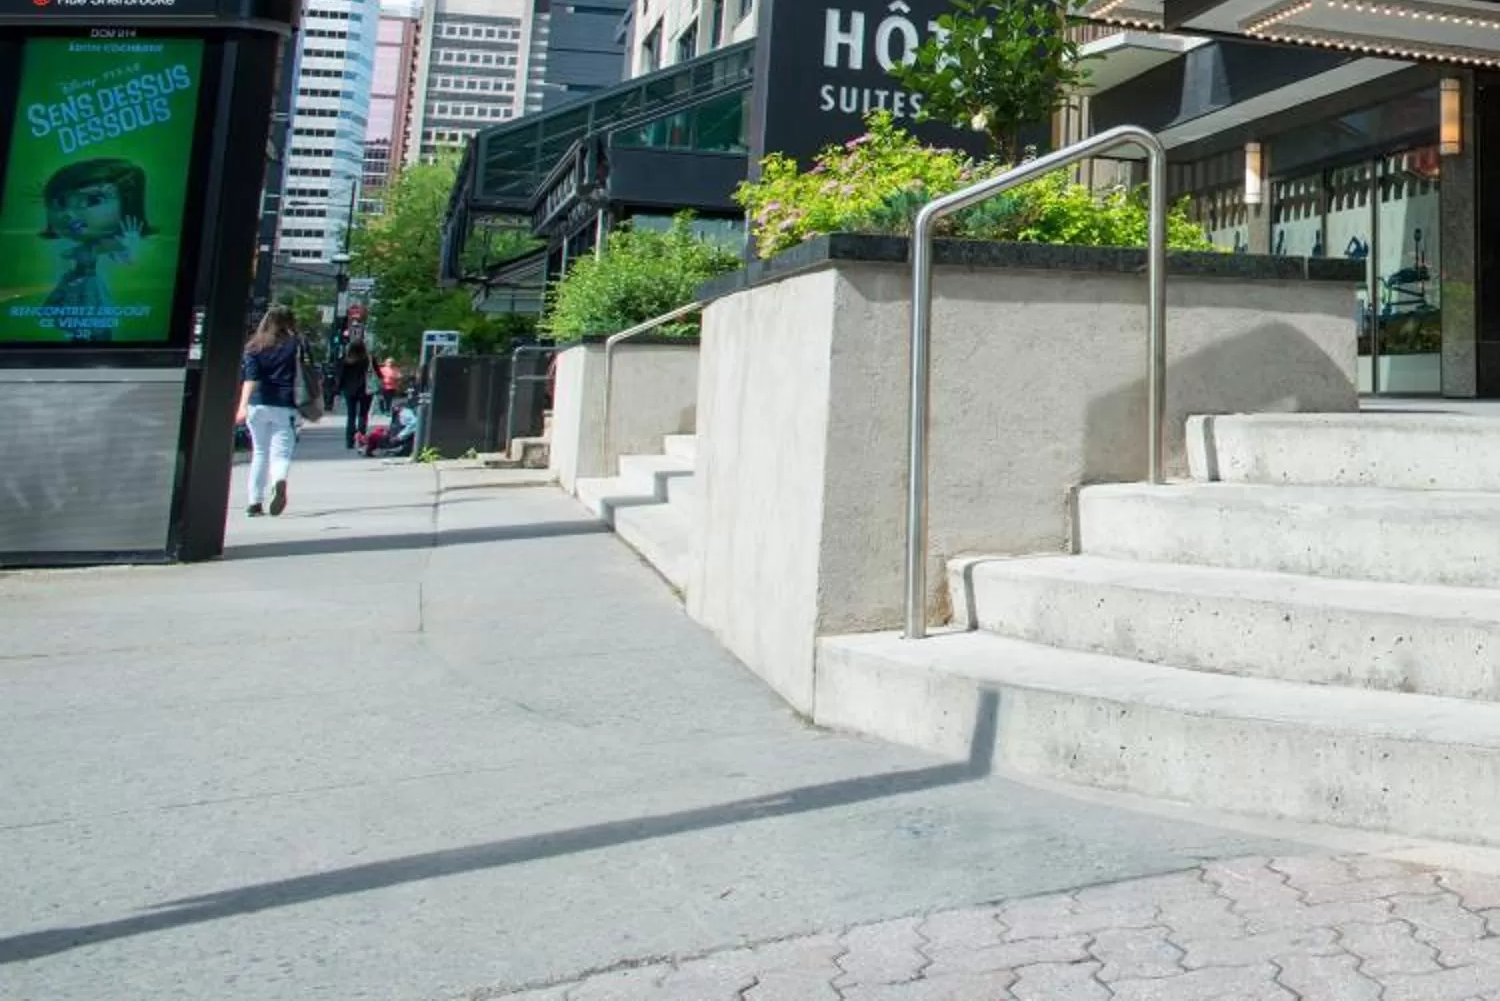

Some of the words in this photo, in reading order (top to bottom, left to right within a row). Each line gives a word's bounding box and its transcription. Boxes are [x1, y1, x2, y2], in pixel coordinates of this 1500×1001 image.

[27, 94, 95, 138] SENS
[96, 64, 192, 113] DESSUS
[57, 97, 172, 154] DESSOUS
[819, 83, 923, 119] SUITES
